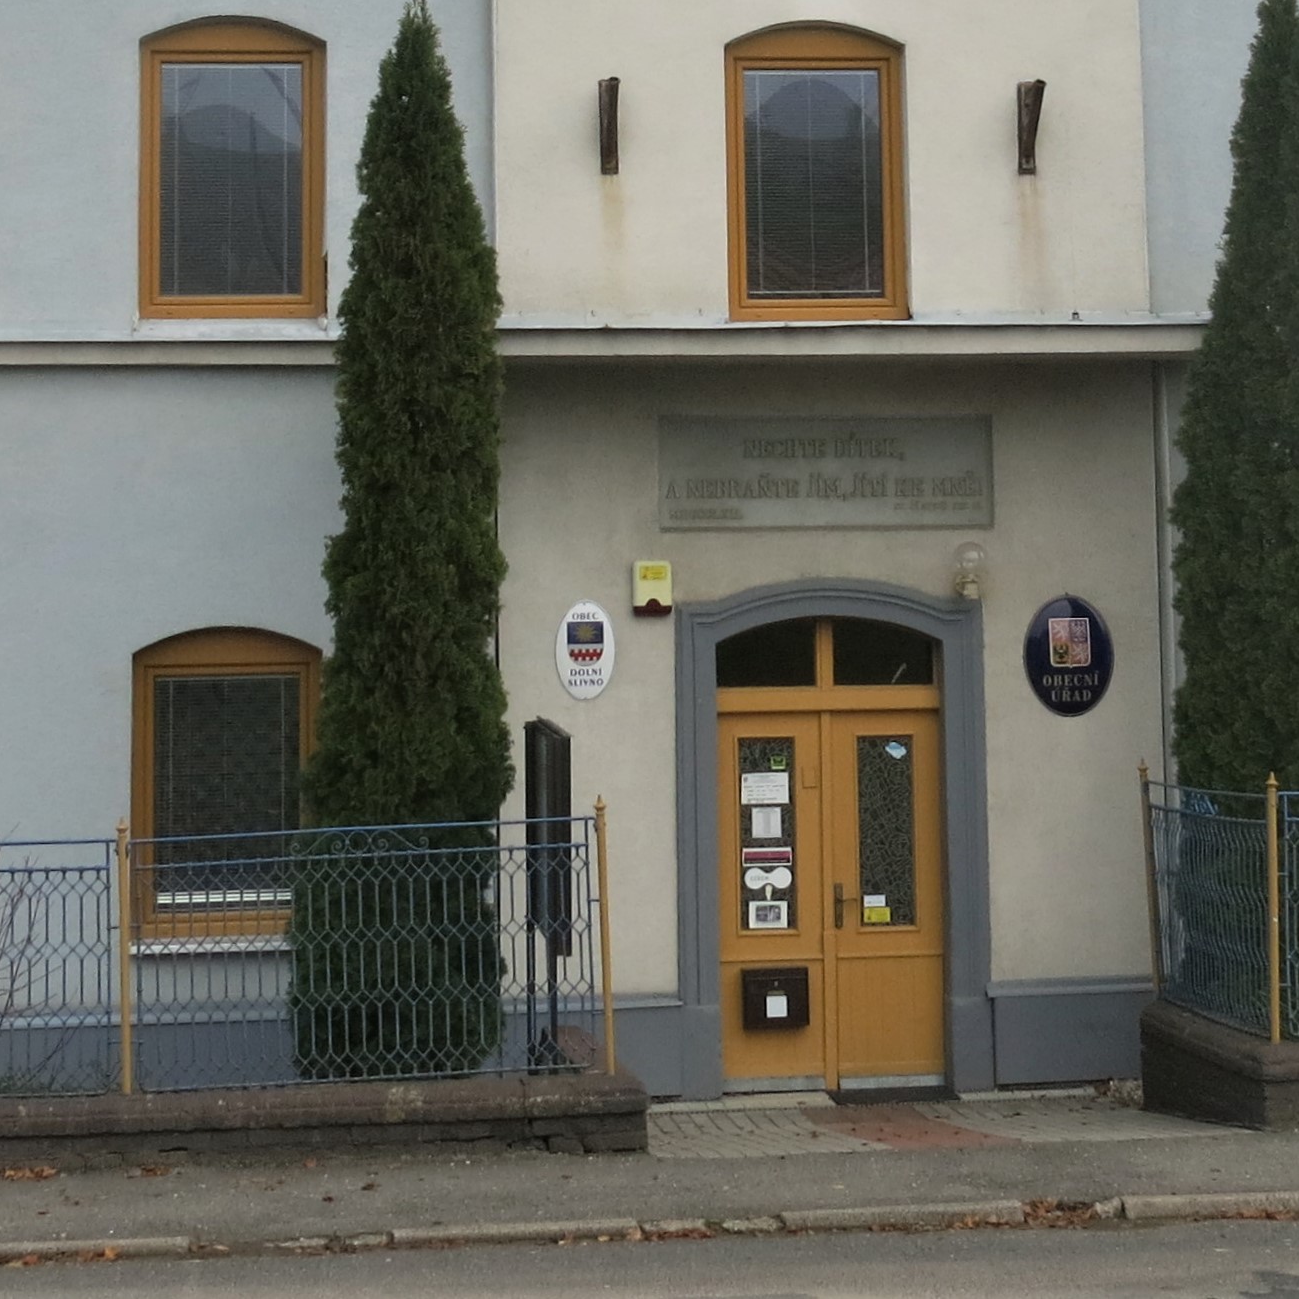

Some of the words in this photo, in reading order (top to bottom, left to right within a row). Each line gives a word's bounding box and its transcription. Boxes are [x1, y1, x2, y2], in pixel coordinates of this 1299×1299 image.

[665, 481, 680, 499] A
[572, 612, 599, 621] OBEC
[568, 678, 604, 687] SLIVNO
[1042, 670, 1099, 687] OBECNÍ
[1050, 686, 1092, 702] ÚŘAD
